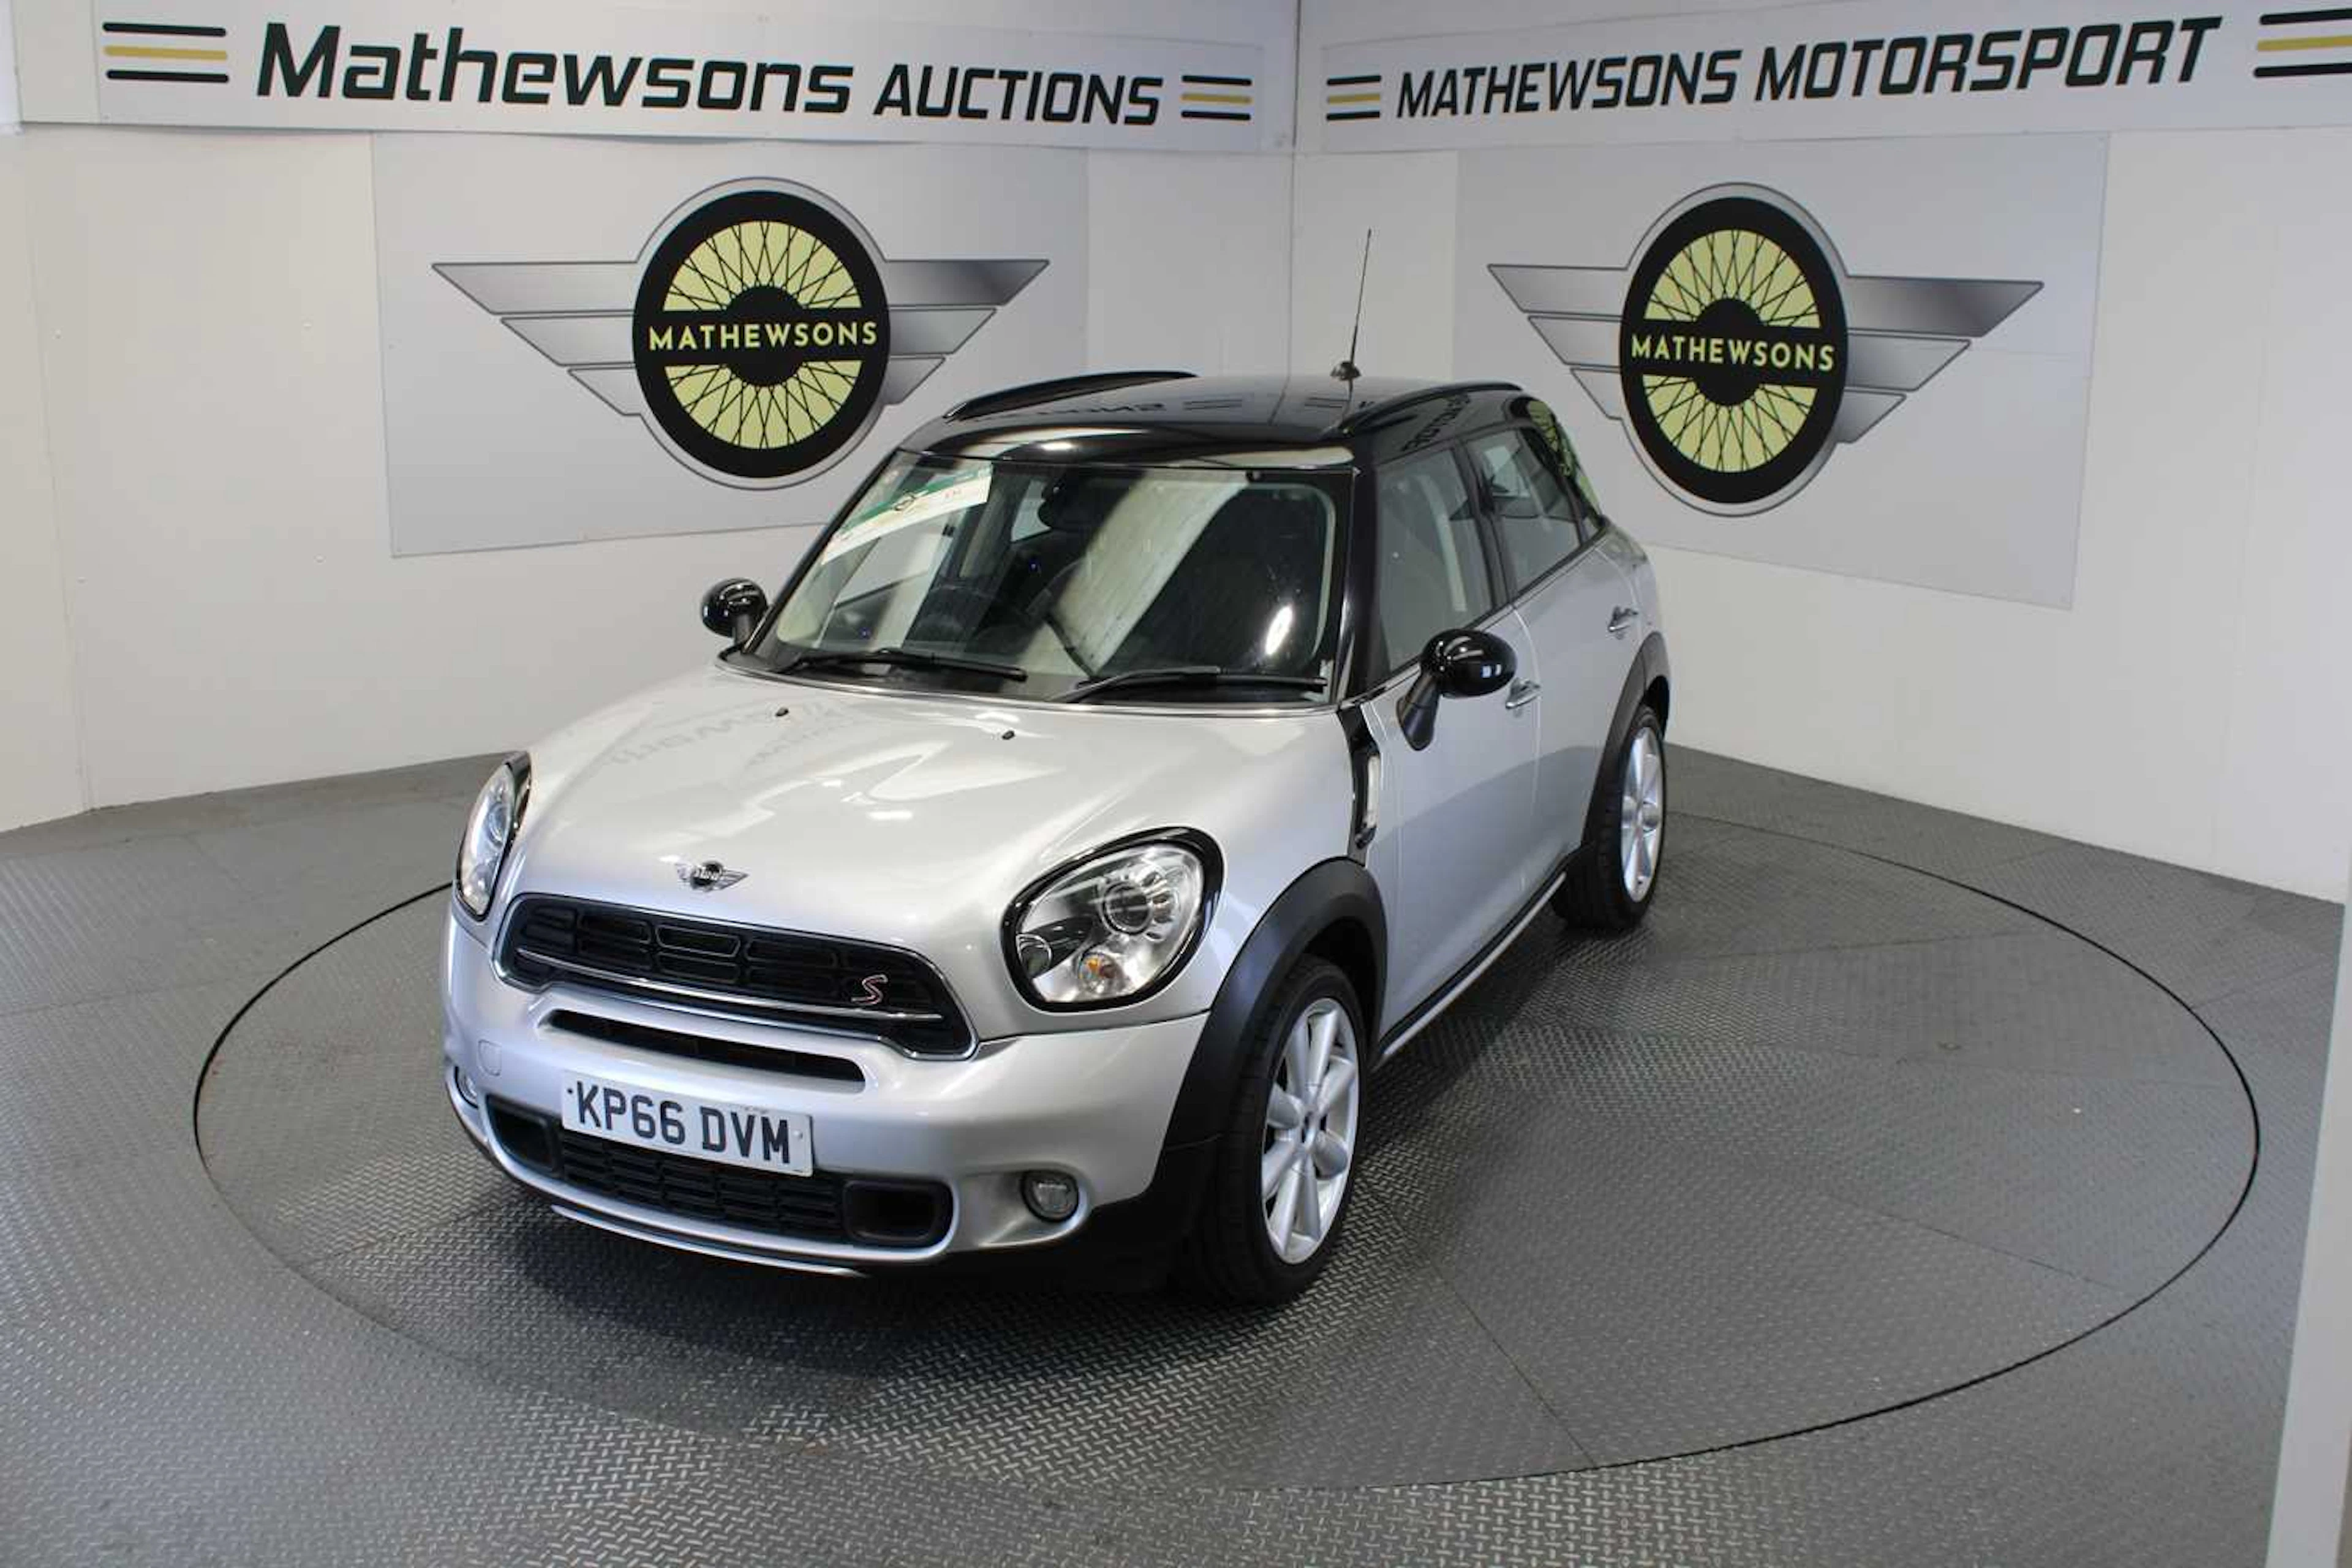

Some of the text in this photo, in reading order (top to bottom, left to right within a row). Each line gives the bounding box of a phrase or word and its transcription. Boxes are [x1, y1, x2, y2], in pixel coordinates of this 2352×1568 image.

[257, 23, 1163, 125] Mathewsons AUCTIONS
[1397, 17, 2222, 118] MATHEWSONS MOTORSPORT
[649, 321, 877, 351] MATHEWSONS
[1631, 334, 1834, 371] MATHEWSONS
[851, 973, 888, 1006] S
[576, 1080, 790, 1163] KP66 DVM
